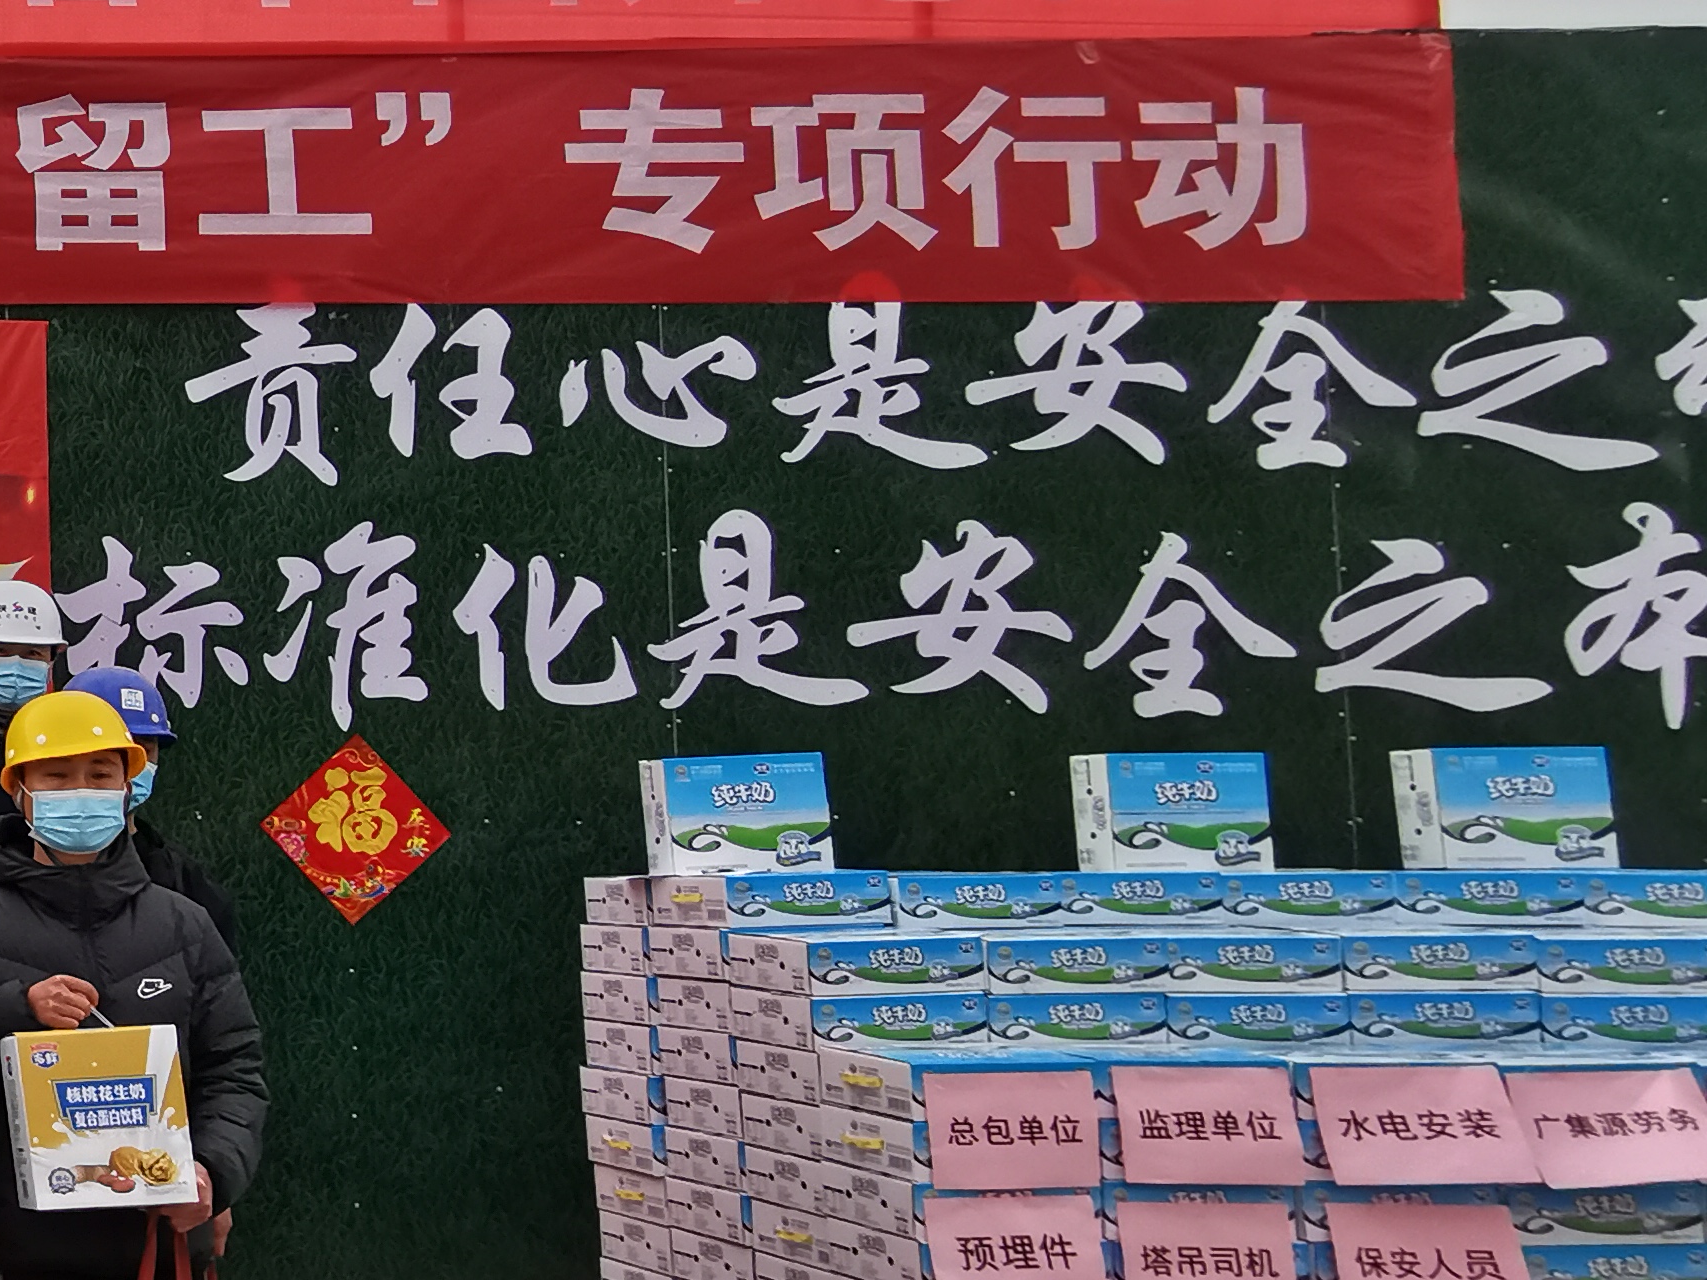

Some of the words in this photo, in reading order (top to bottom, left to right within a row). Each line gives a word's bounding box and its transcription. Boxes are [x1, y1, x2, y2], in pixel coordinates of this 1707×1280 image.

[564, 84, 1309, 254] 专项行动
[185, 289, 1707, 487] 责任心是安全之
[54, 501, 1707, 732] 标准化是安全之本
[308, 766, 398, 855] 福
[65, 1083, 146, 1103] 核桃花生奶
[948, 1116, 1084, 1148] 总包单位
[1139, 1109, 1283, 1141] 监理单位
[1339, 1109, 1501, 1141] 水电安装
[1535, 1107, 1701, 1140] 广集源劳务
[957, 1233, 1078, 1273] 预埋件
[1140, 1245, 1281, 1280] 塔吊司机
